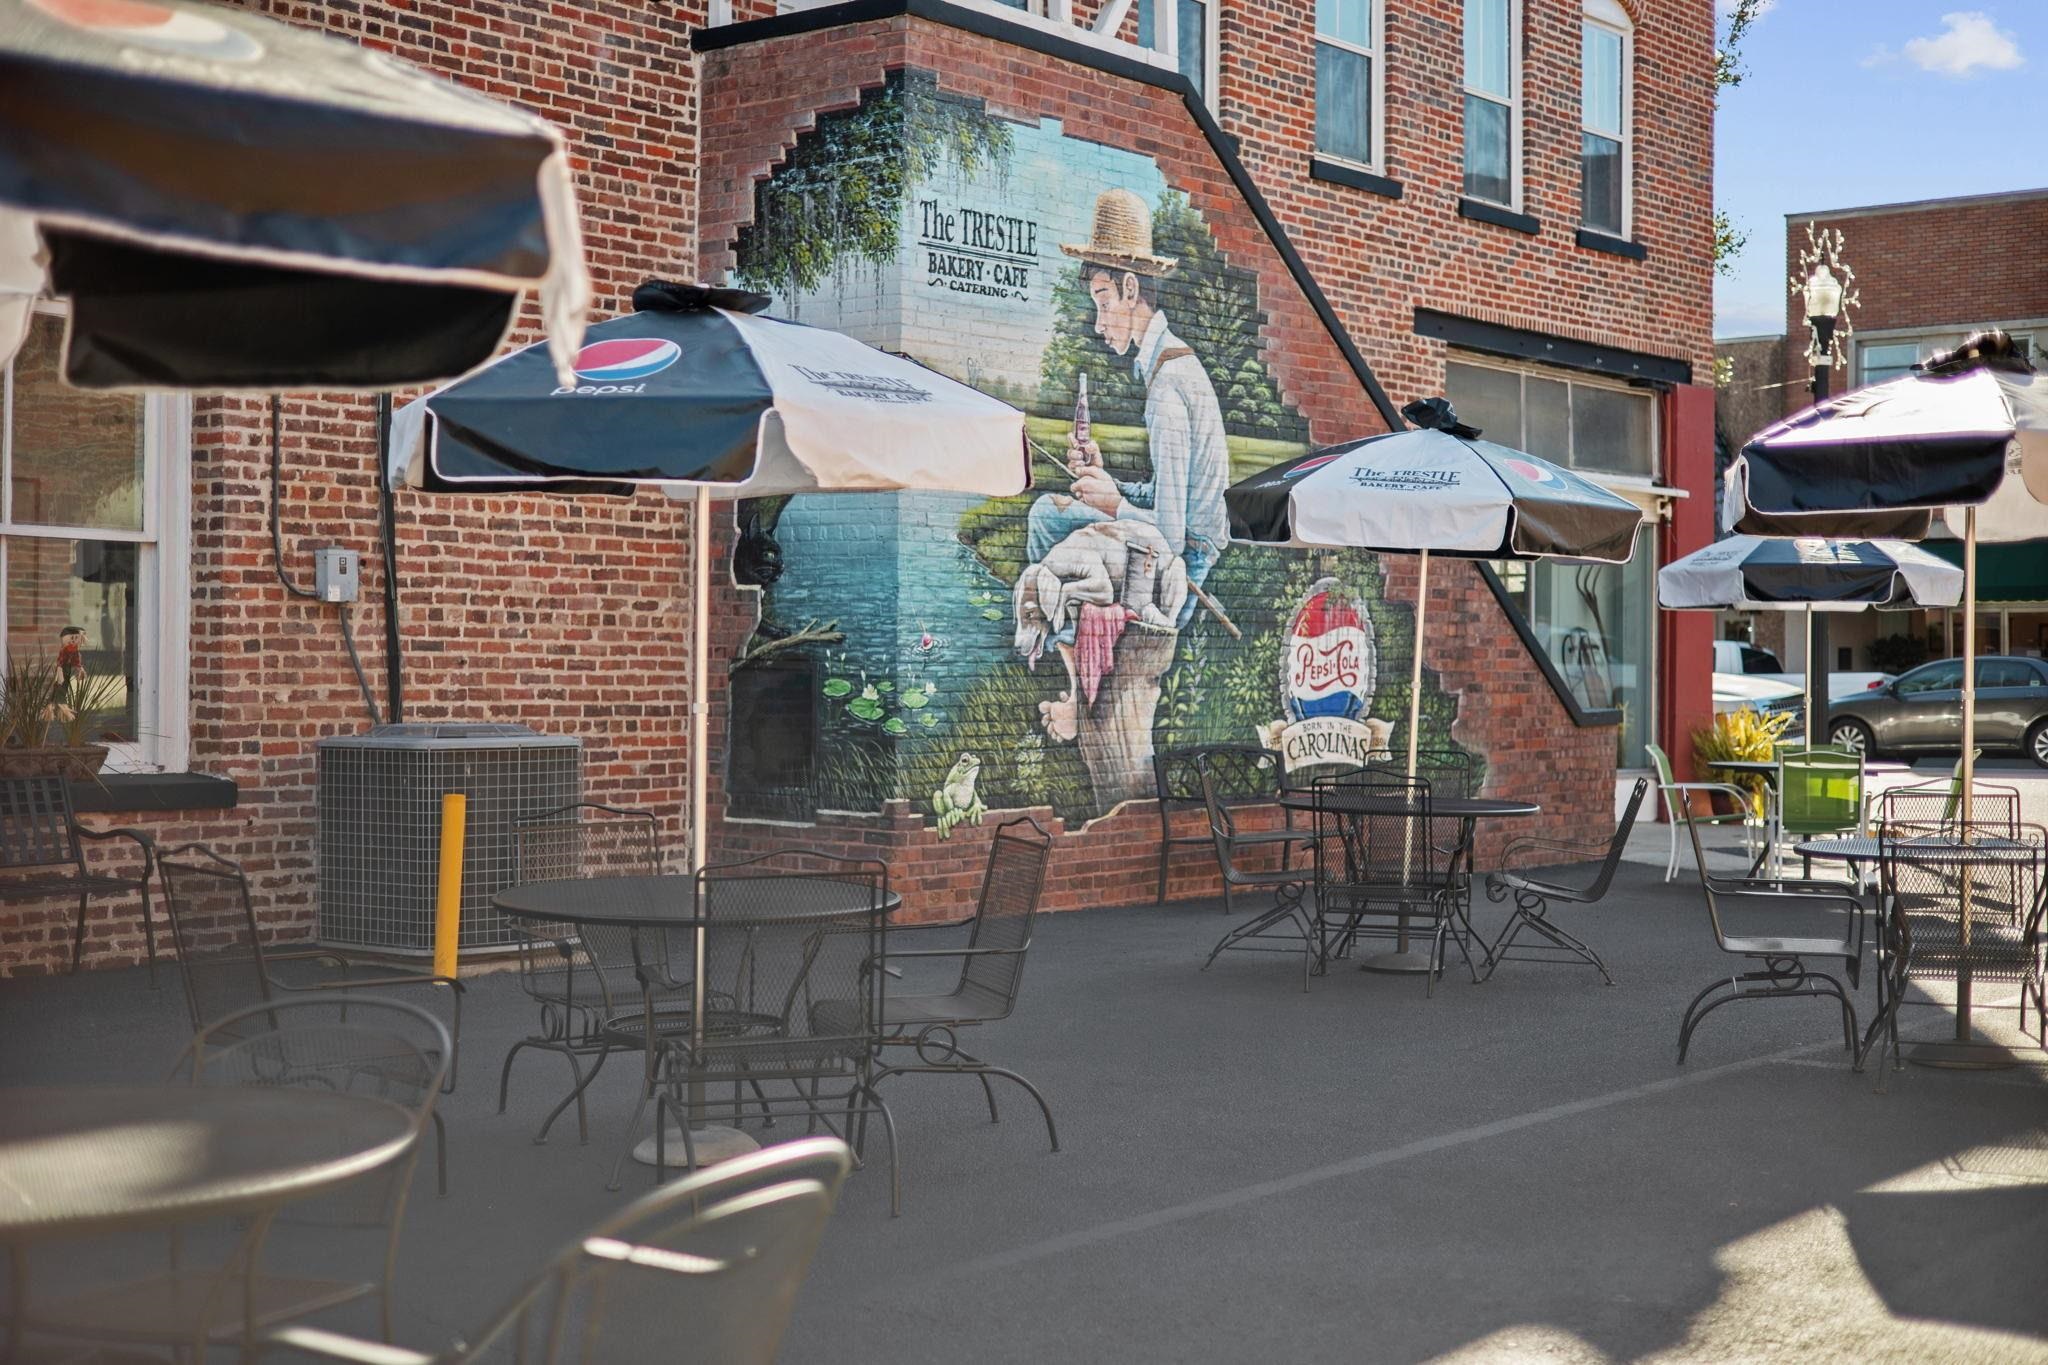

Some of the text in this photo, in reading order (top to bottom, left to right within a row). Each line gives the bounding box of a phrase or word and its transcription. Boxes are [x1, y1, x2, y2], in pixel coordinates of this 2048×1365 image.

[920, 199, 1038, 257] The TRESTLE
[928, 252, 1028, 288] BAKERY CAFE
[950, 280, 1008, 298] CATERING
[549, 383, 646, 396] pepsi
[1354, 467, 1461, 482] The TRESTLE
[1302, 722, 1352, 734] BORN IN THE
[1287, 732, 1367, 761] CAROLINAS
